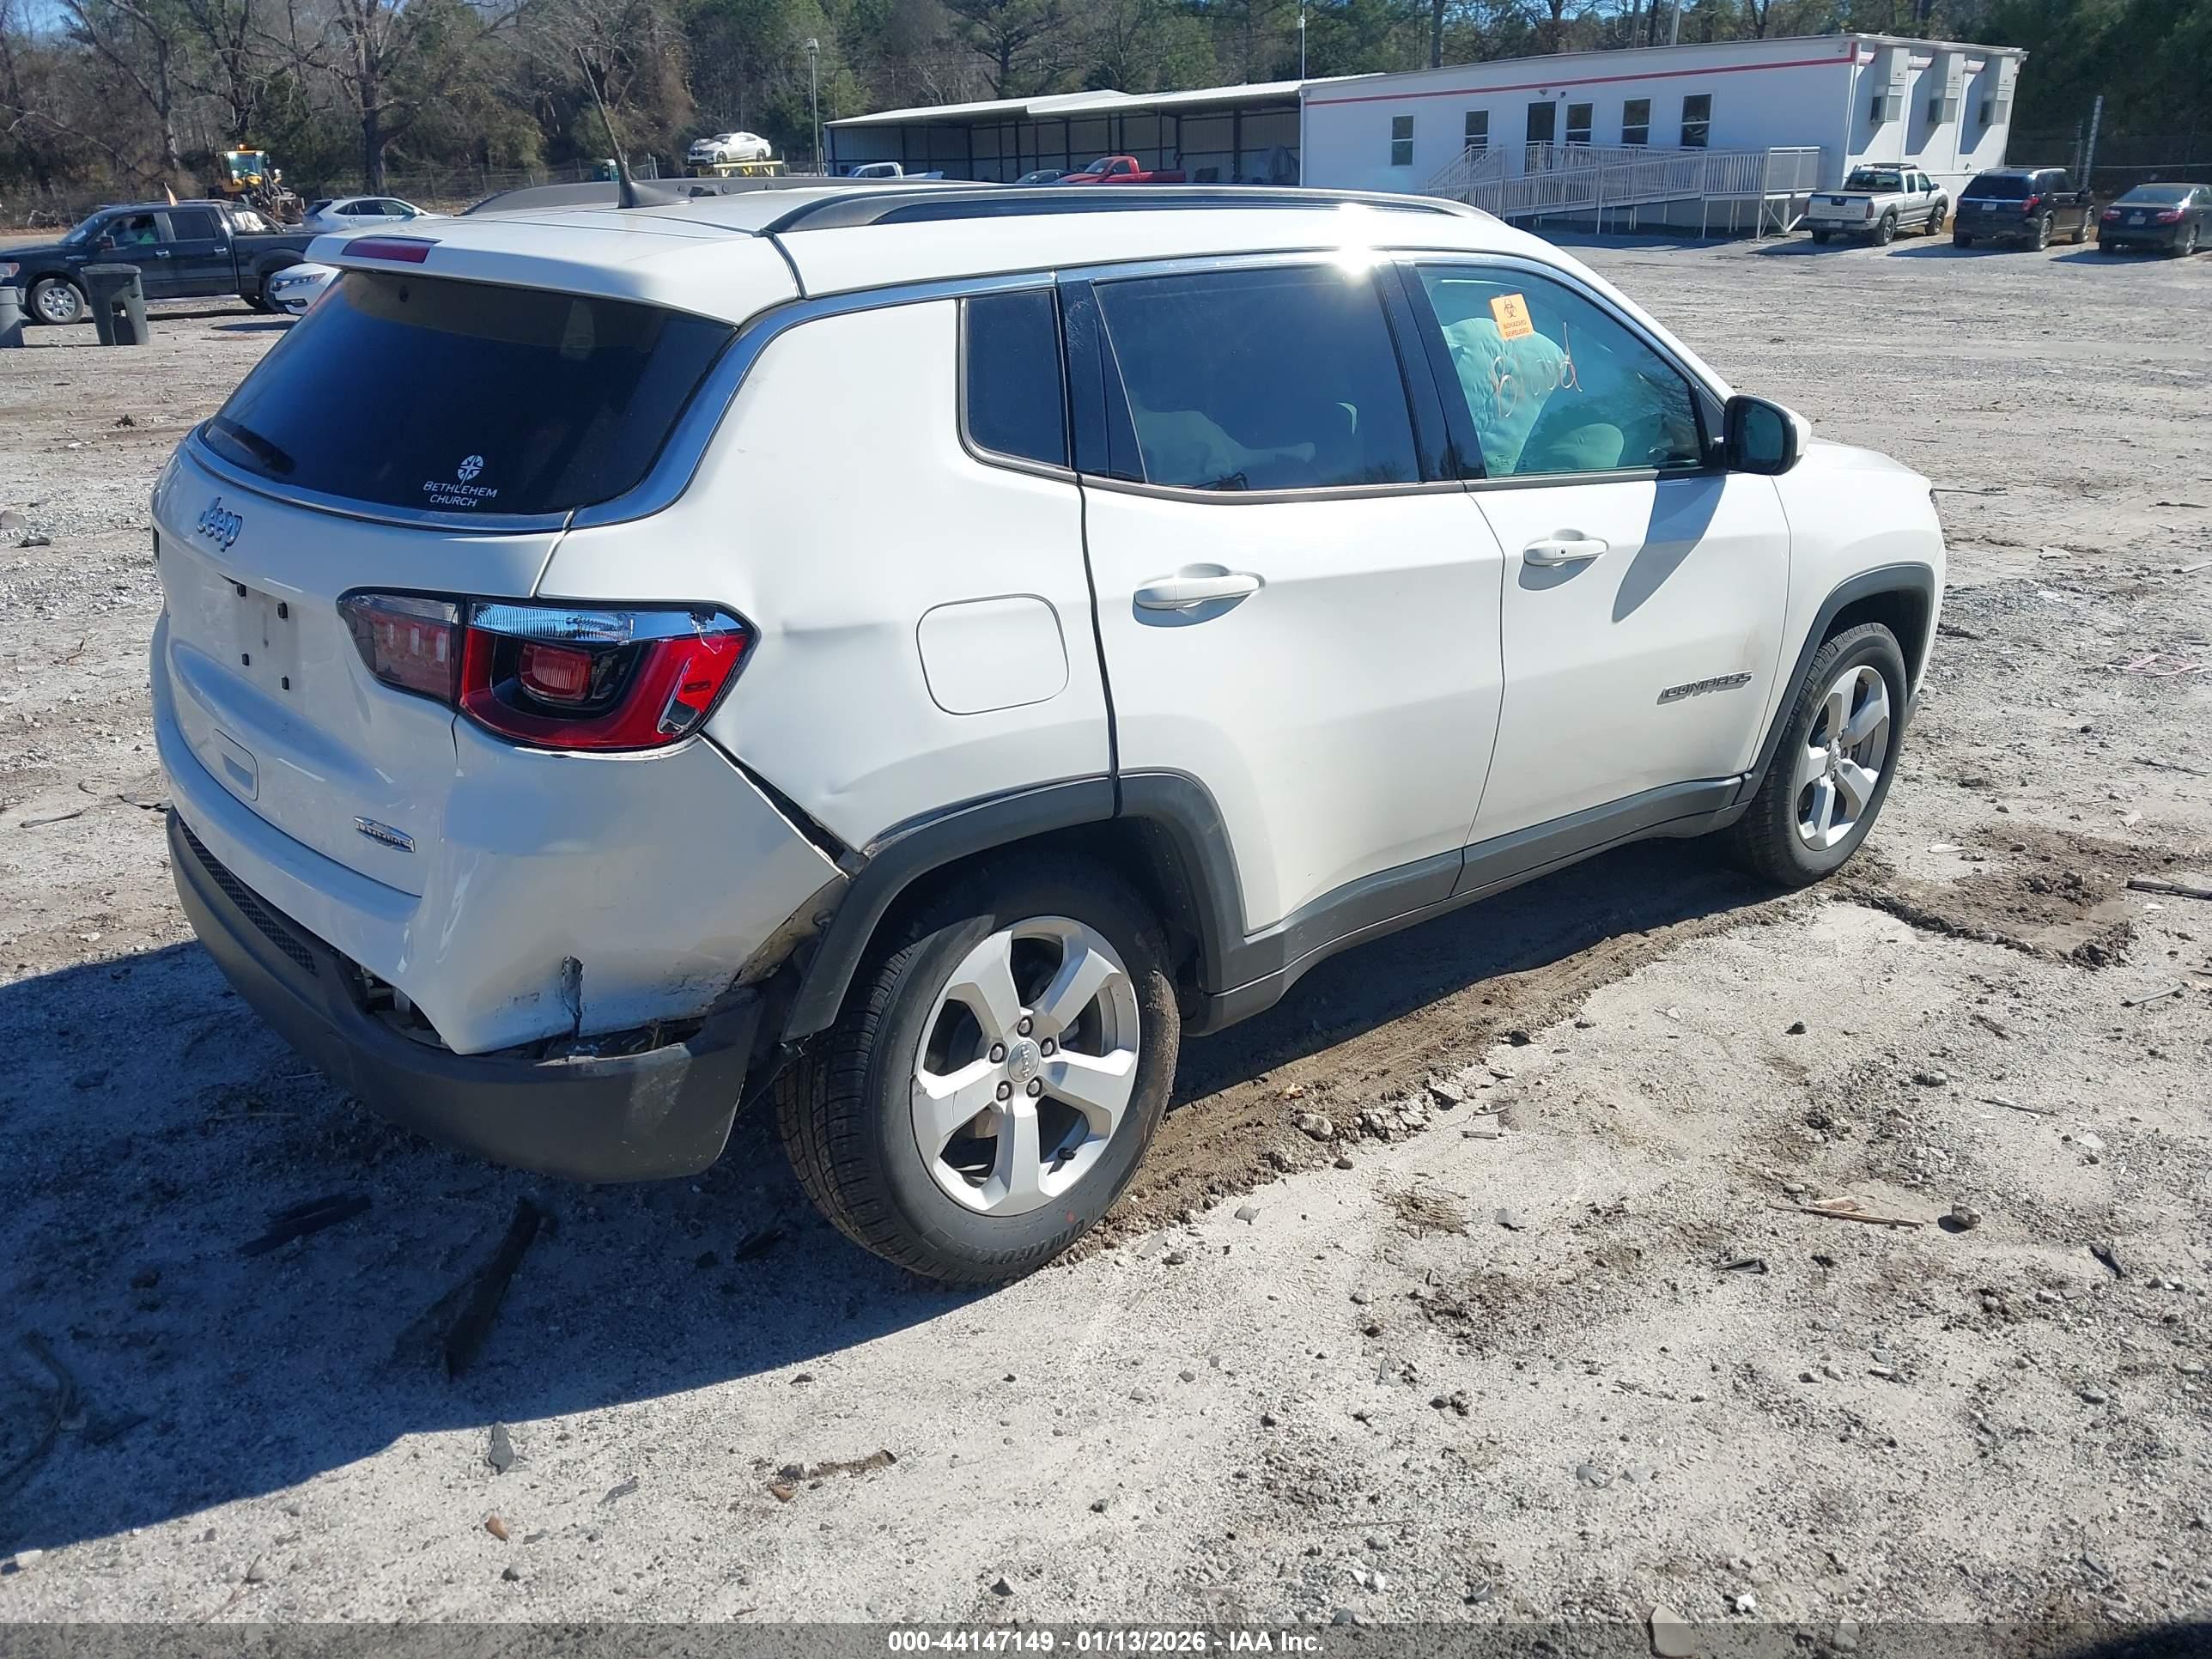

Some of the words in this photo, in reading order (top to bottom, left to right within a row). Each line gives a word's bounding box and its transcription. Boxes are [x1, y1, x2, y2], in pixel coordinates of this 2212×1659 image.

[423, 481, 498, 498] BETHLEHEM
[429, 494, 478, 507] CHURCH
[197, 496, 243, 553] Jeep
[1659, 670, 1753, 700] COMPASS
